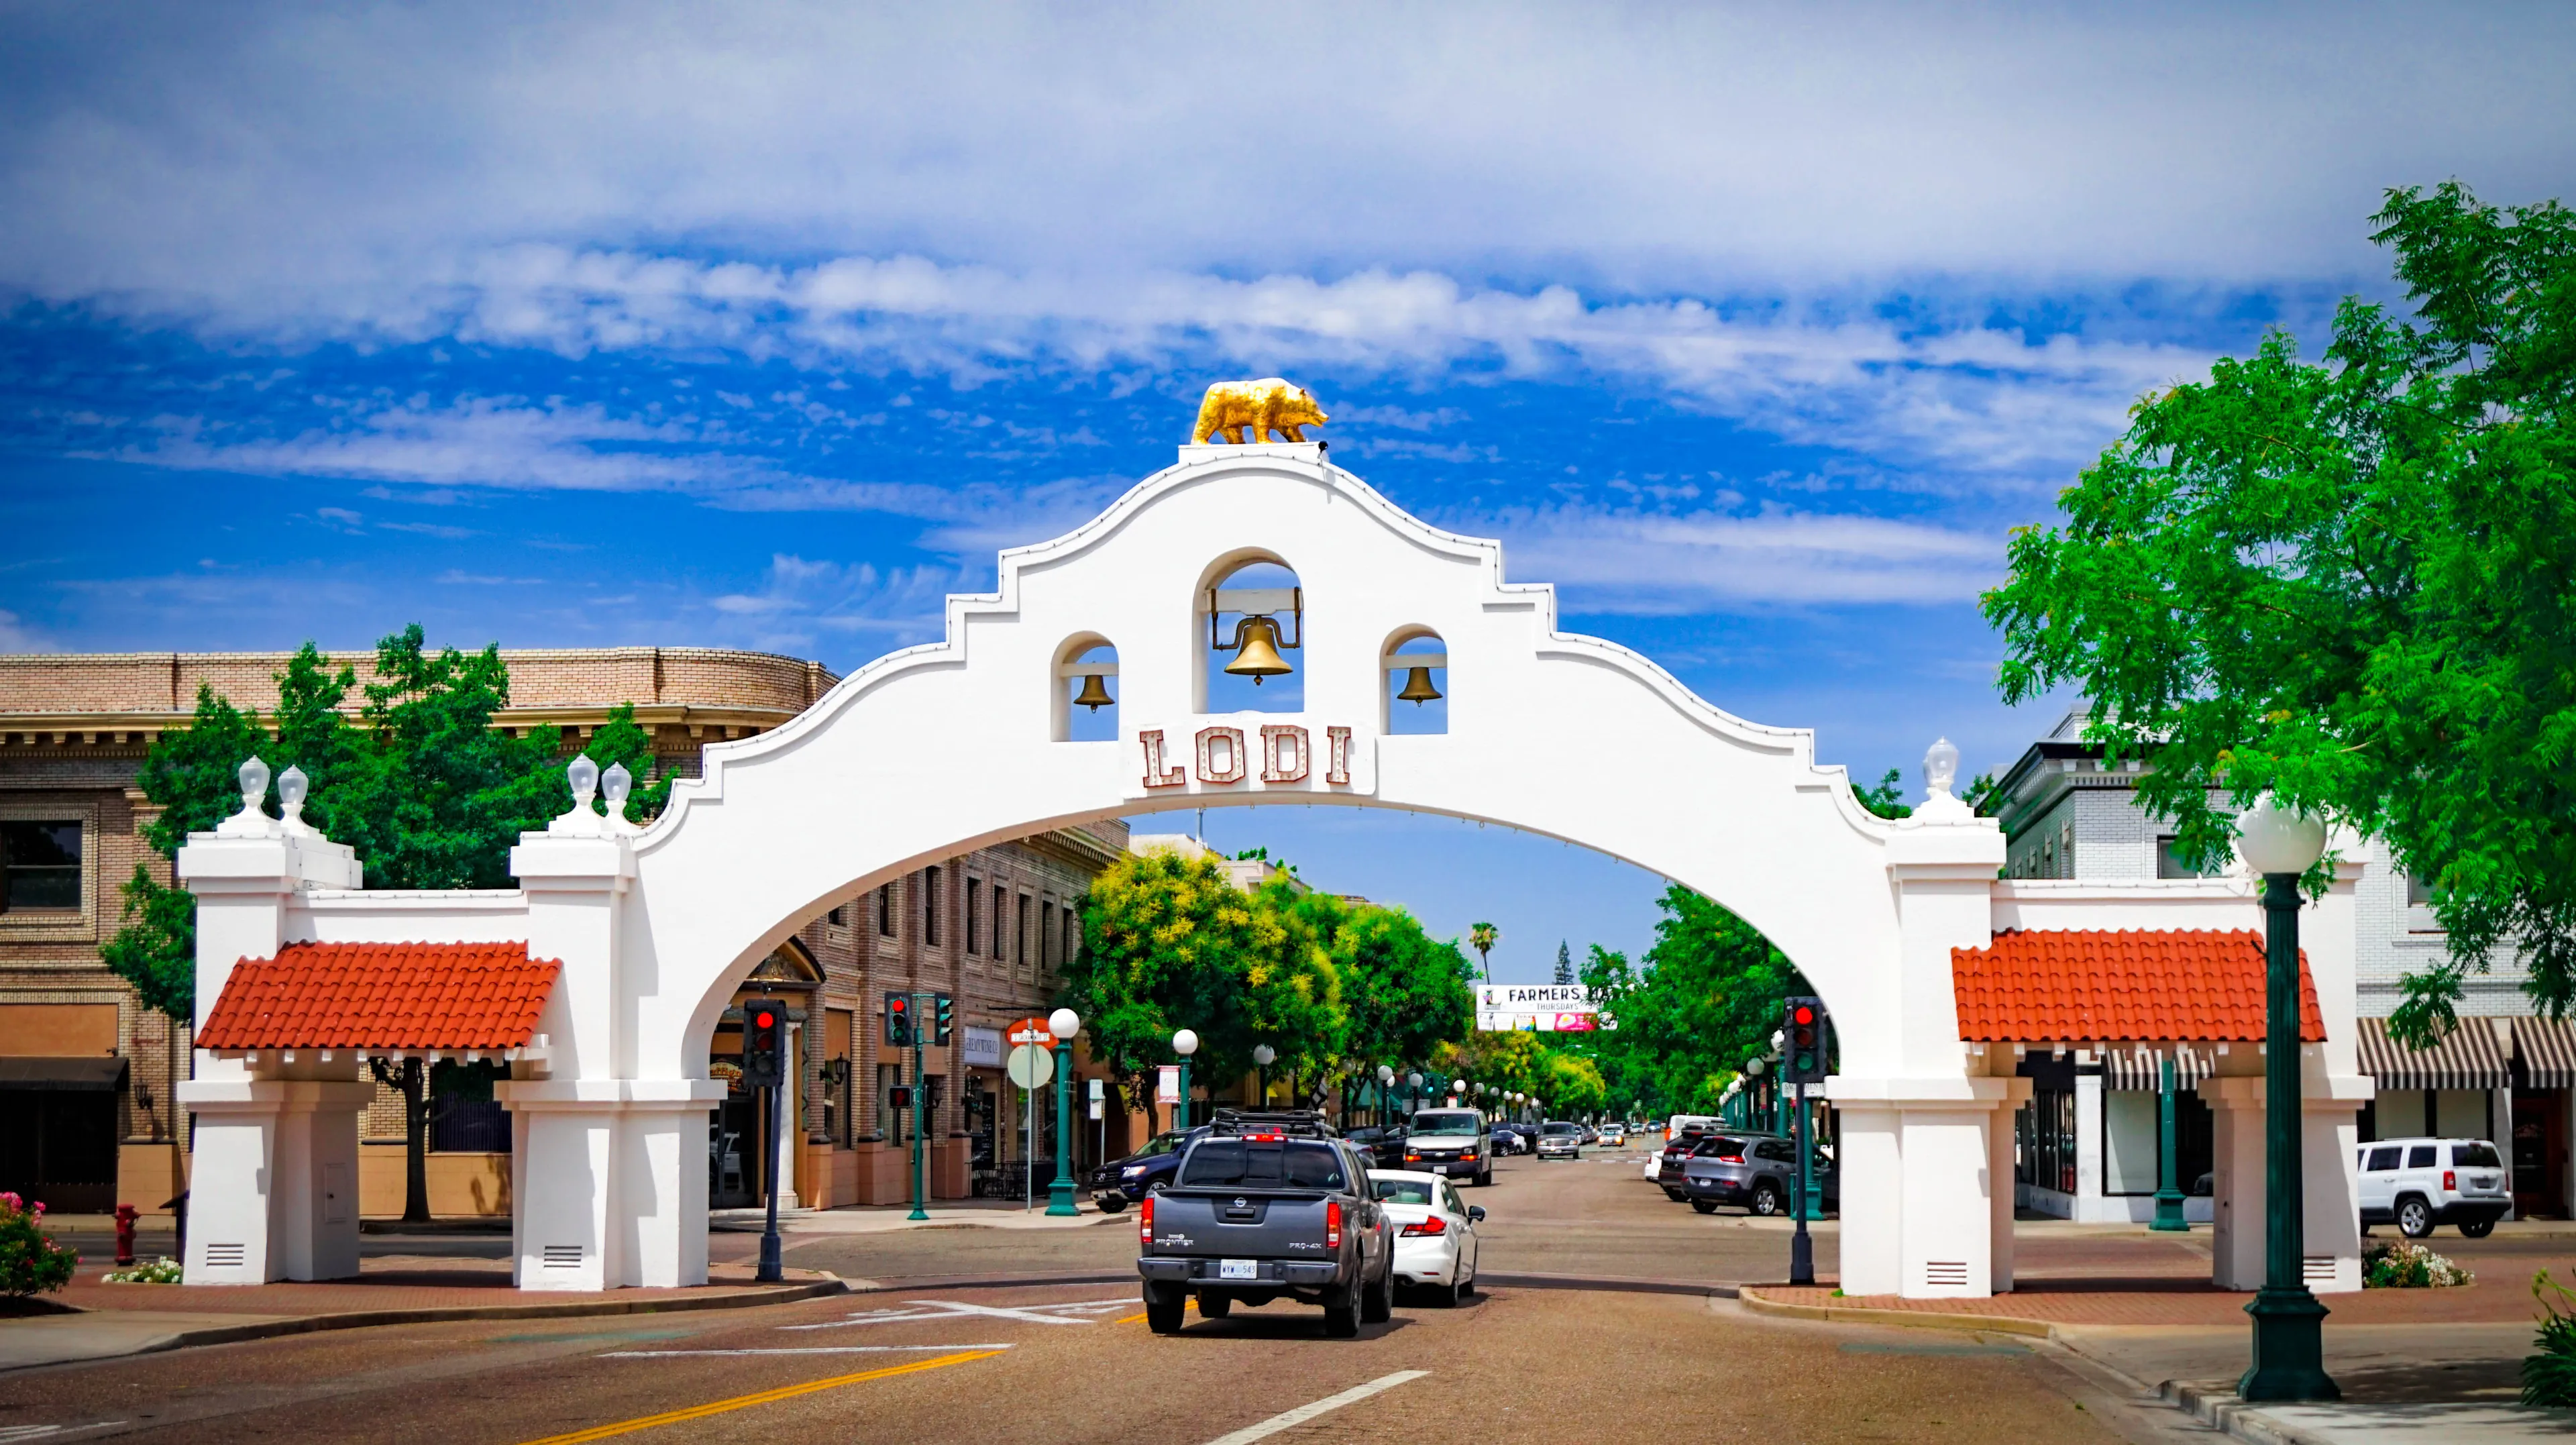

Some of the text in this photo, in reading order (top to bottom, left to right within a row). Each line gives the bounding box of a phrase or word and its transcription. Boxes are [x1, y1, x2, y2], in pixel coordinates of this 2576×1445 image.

[1140, 725, 1351, 788] LODI
[1509, 987, 1580, 1002] FARMERS
[966, 1038, 981, 1051] EREMY
[1155, 1238, 1194, 1246] FRONTIER
[1242, 1265, 1255, 1273] 543
